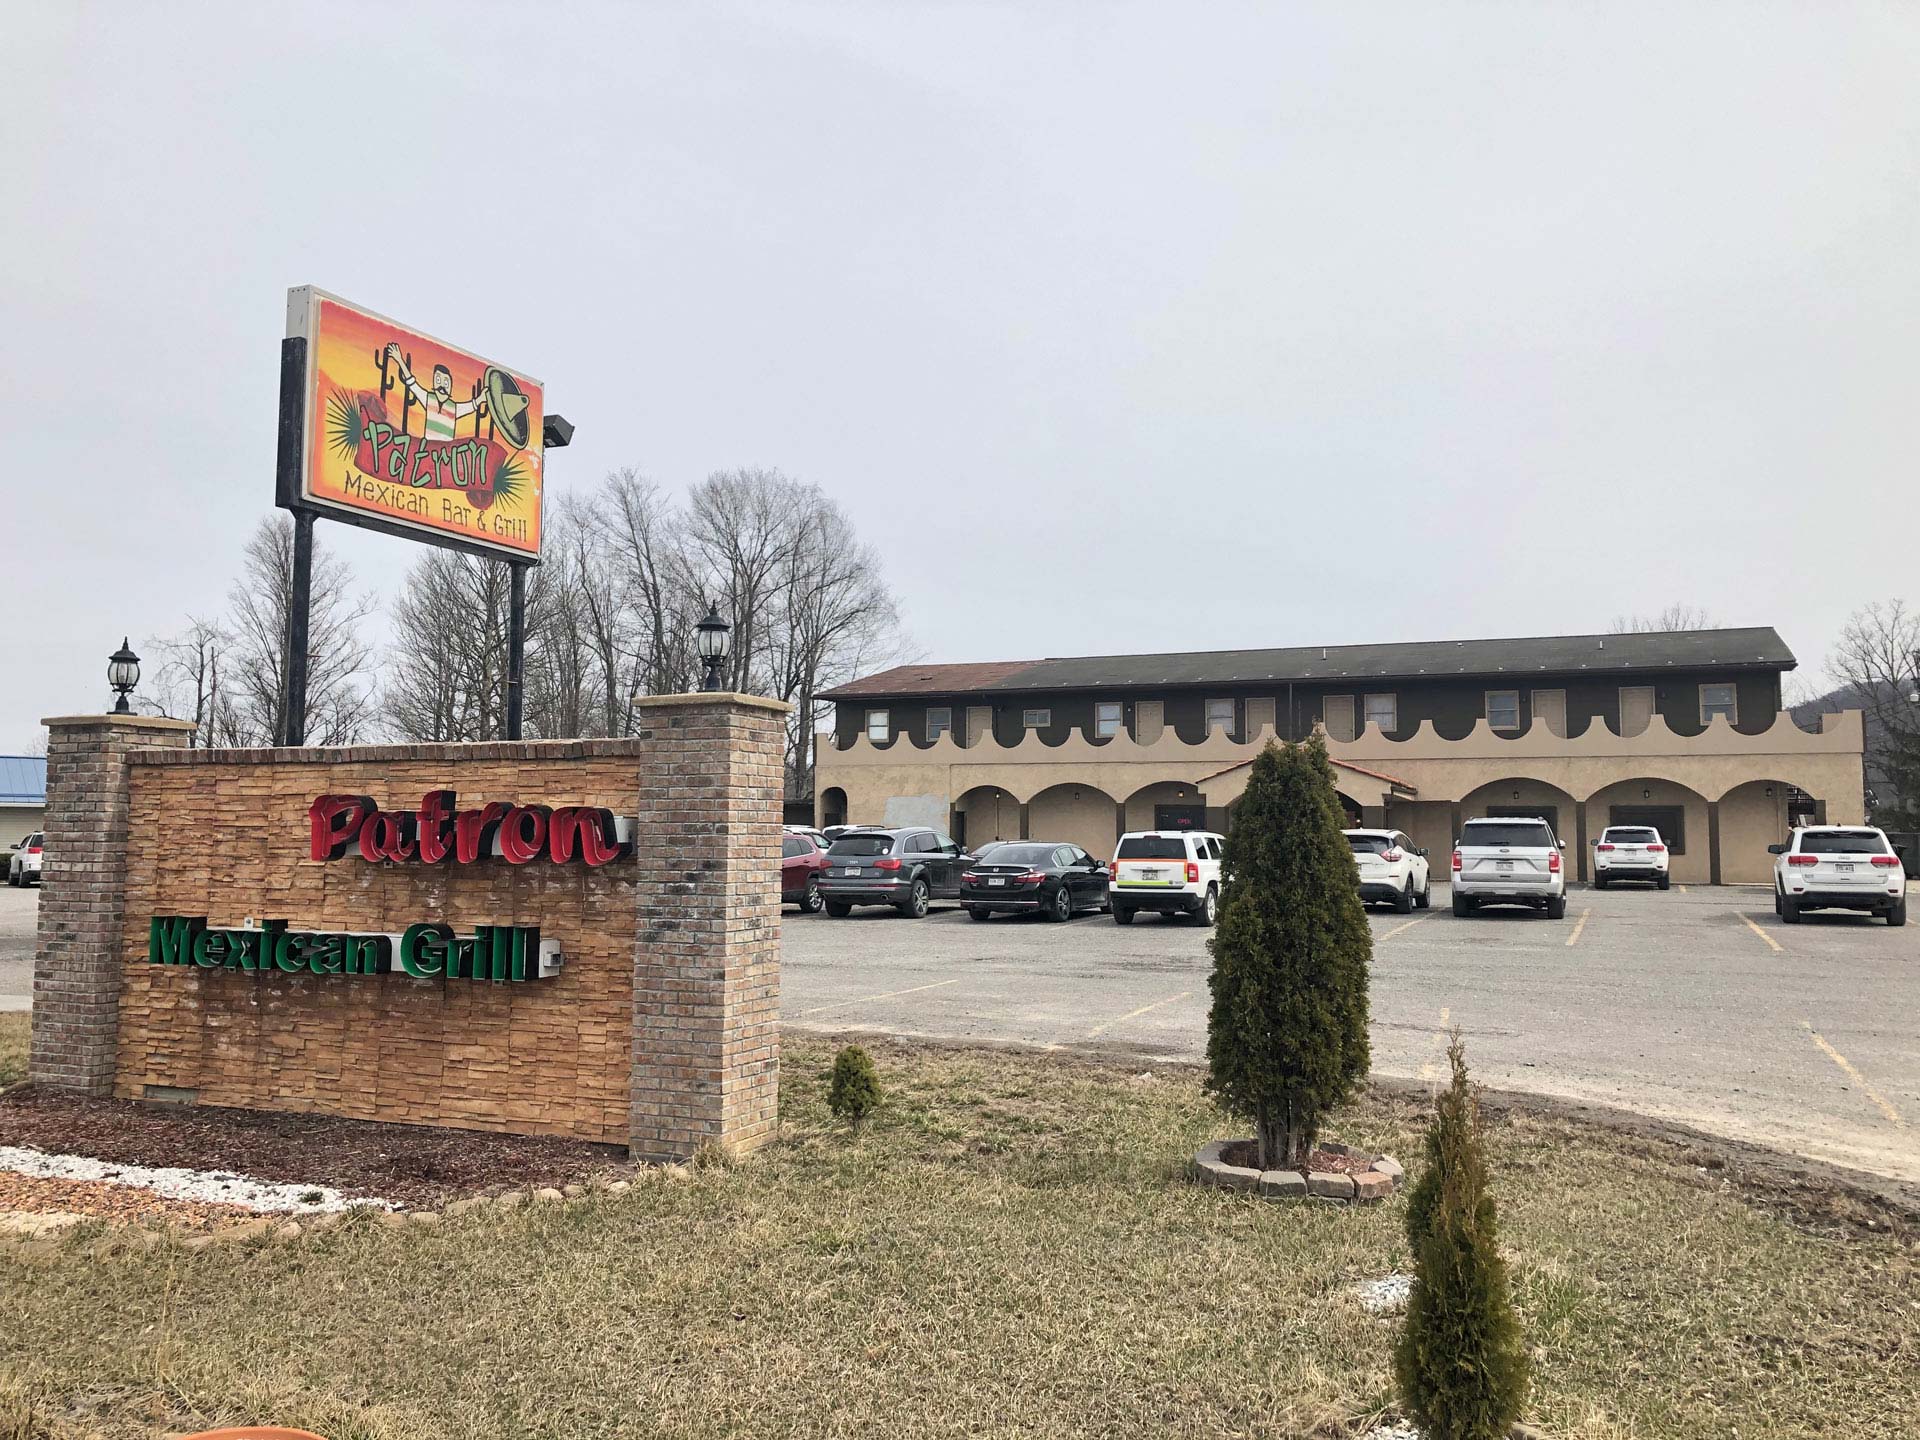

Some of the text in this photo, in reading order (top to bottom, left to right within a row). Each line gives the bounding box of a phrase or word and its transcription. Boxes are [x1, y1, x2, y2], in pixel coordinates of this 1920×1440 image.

[363, 420, 489, 489] Patron
[343, 469, 528, 544] Mexican Bar & Grill
[309, 790, 626, 867] Patron
[149, 916, 541, 983] Mexican Grill
